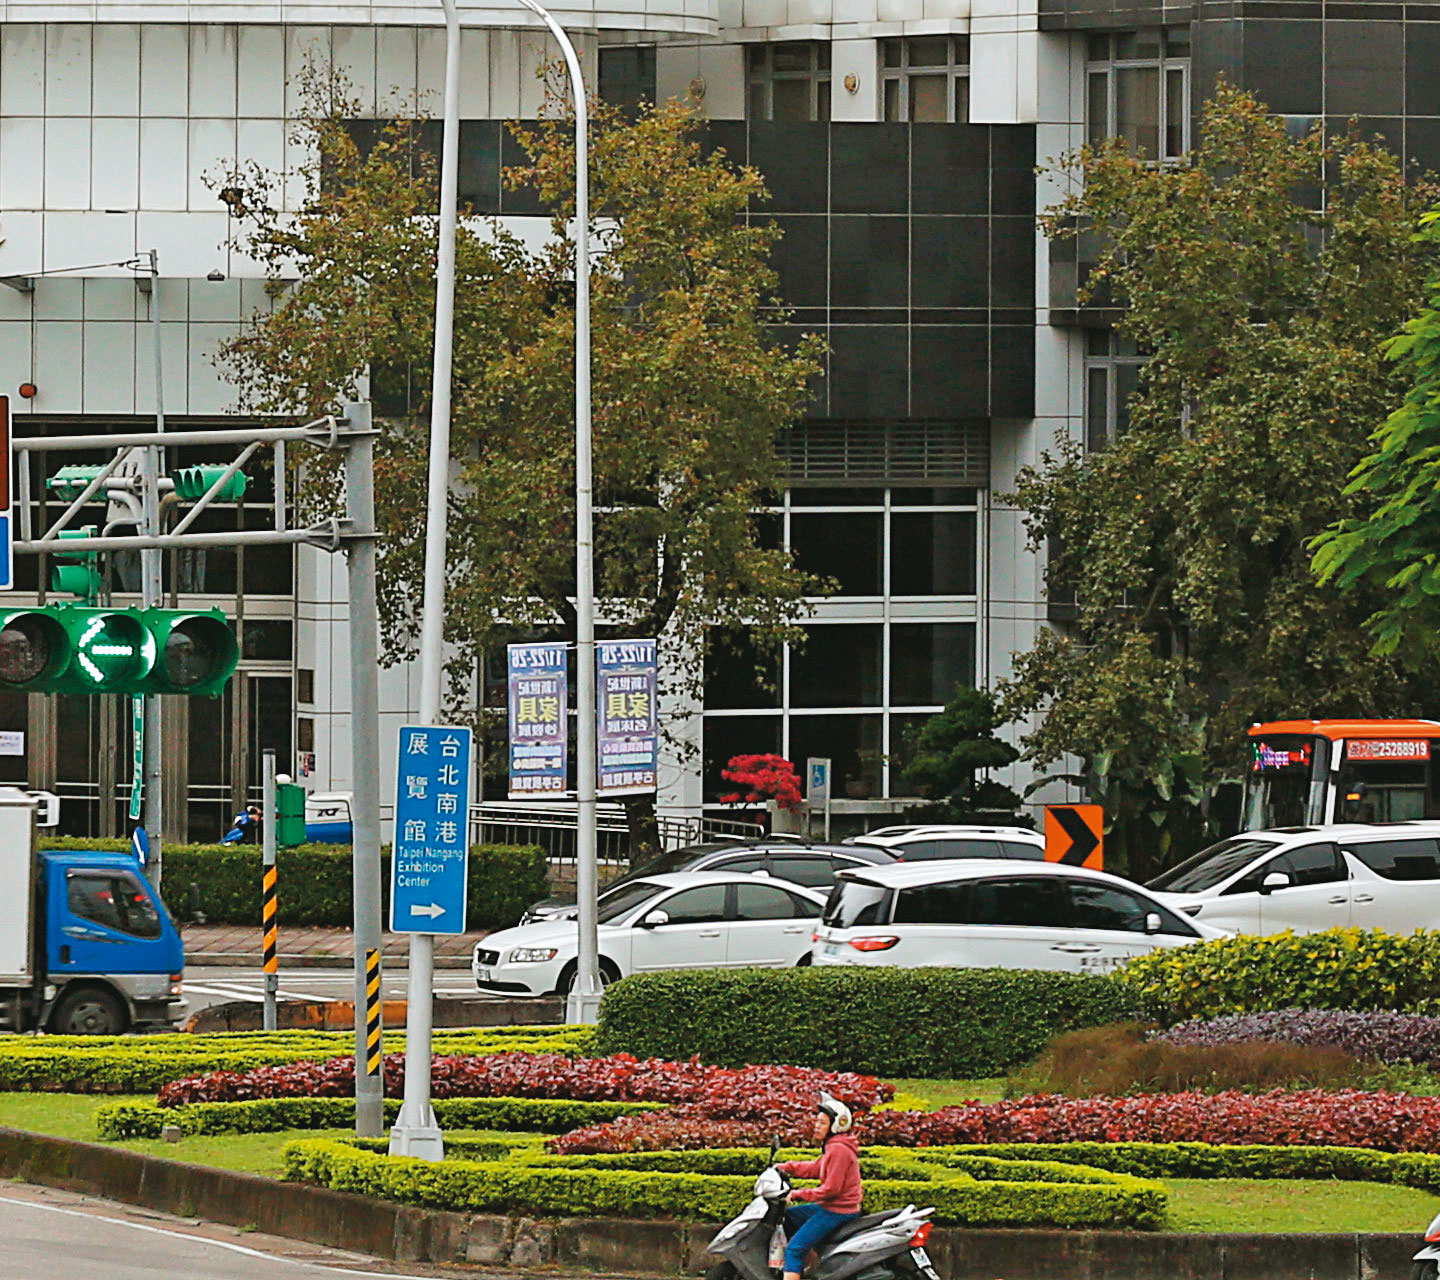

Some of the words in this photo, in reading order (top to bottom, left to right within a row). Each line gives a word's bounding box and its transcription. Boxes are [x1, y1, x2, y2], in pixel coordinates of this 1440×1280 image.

[404, 733, 429, 842] 展覽館
[435, 734, 461, 843] 台北南港
[398, 875, 431, 887] Center
[399, 846, 423, 861] Taipei
[425, 847, 463, 861] Nangang
